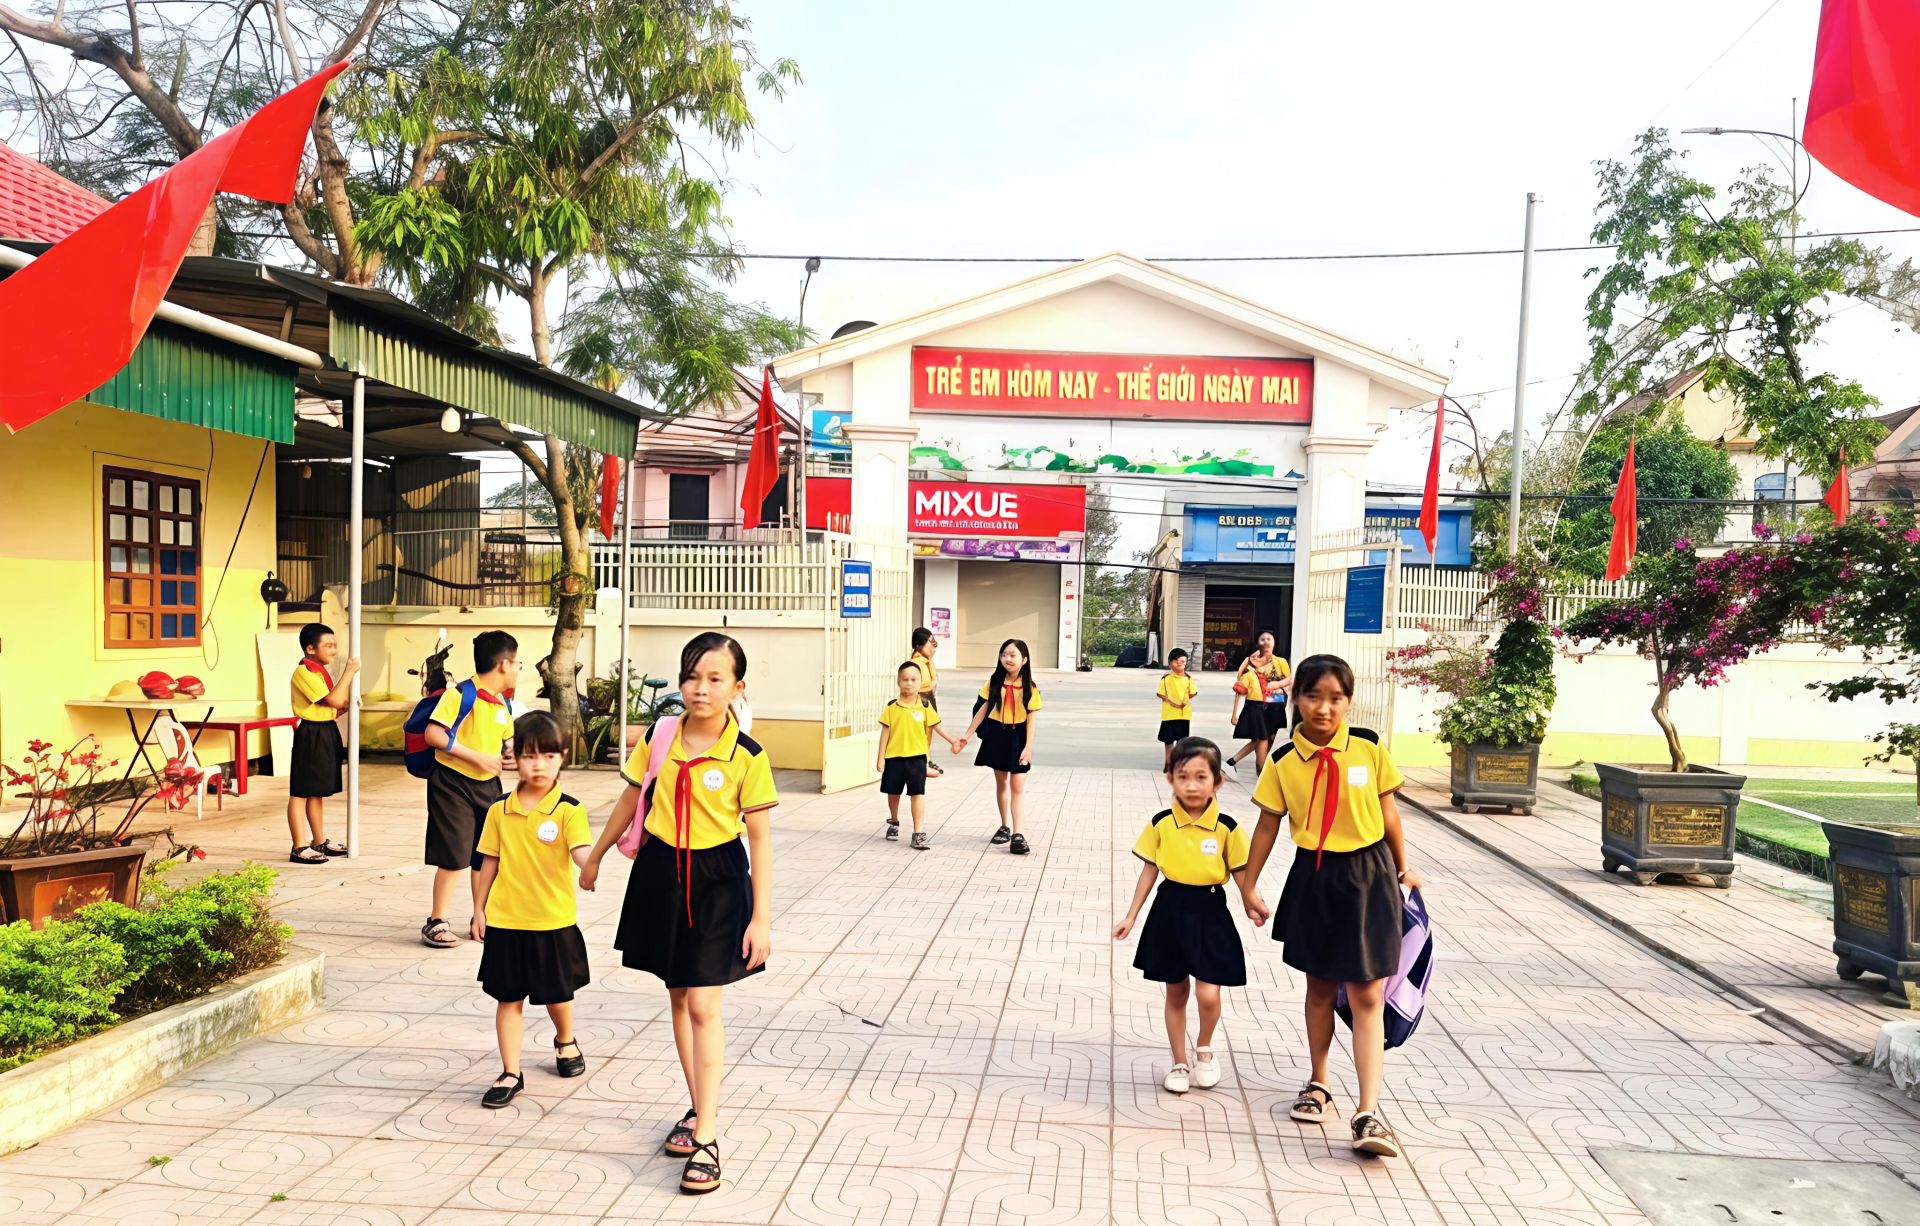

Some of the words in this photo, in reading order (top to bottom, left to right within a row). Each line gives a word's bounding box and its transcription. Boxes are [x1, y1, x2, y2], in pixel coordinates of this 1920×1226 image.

[926, 355, 962, 395] TRẺ
[970, 367, 1000, 396] EM
[1007, 362, 1052, 397] HÔM
[1058, 370, 1098, 399] NAY
[1116, 362, 1152, 400] THẾ
[1157, 365, 1195, 402] GIỚI
[1203, 368, 1254, 403] NGÀY
[1261, 375, 1299, 404] MAI
[915, 489, 1018, 518] MIXUE
